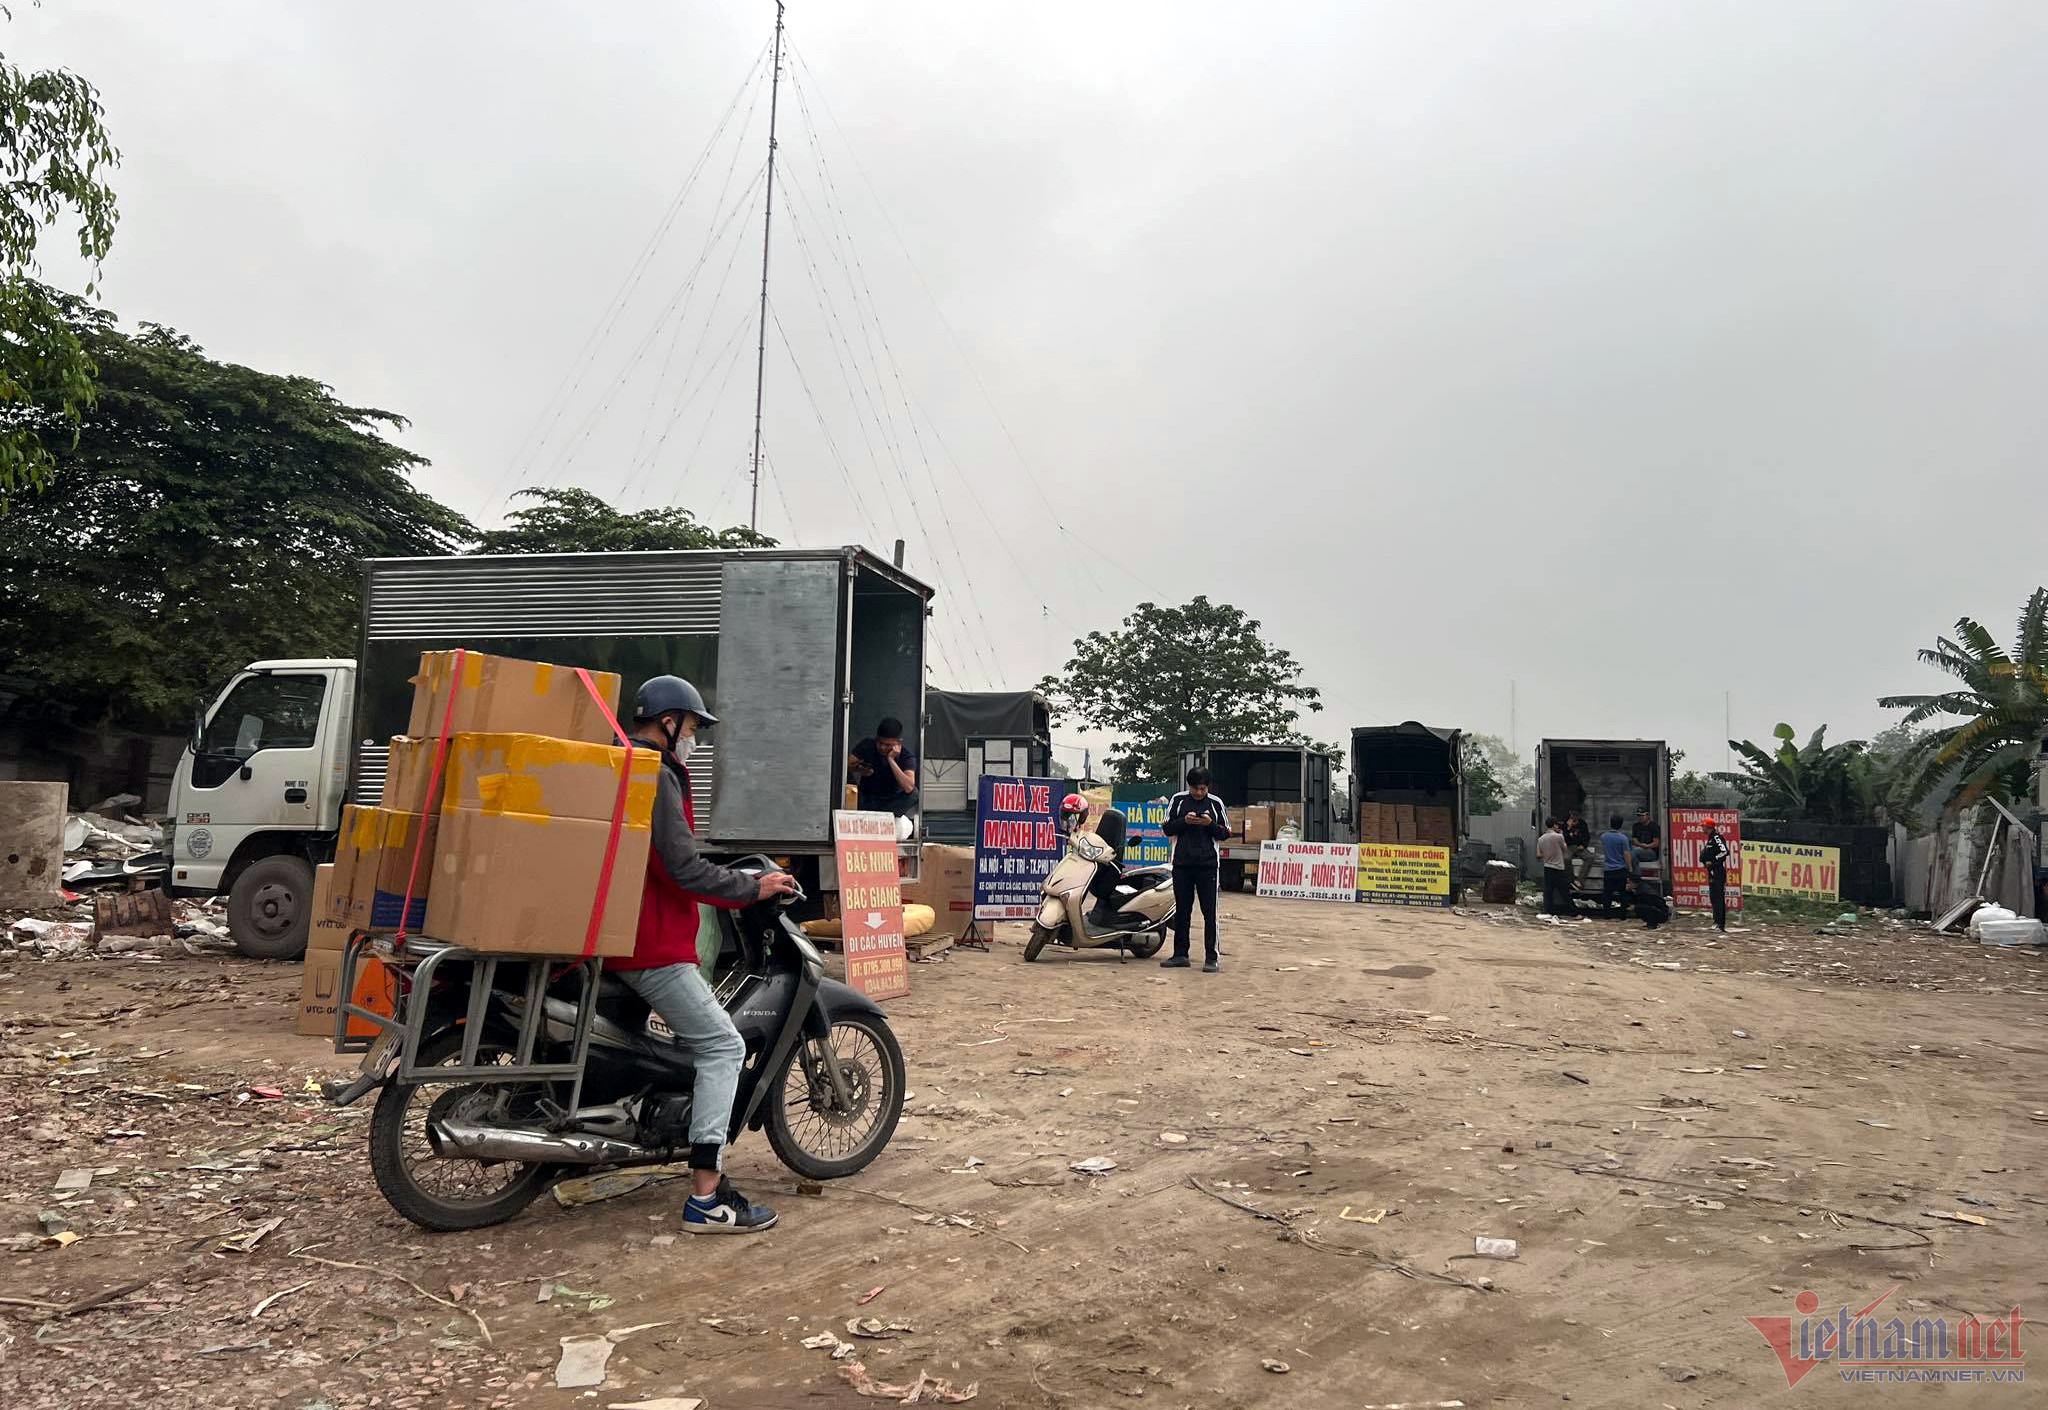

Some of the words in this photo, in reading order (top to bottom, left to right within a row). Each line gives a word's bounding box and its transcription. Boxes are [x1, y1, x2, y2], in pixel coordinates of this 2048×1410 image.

[993, 779, 1026, 812] NHÀ
[1029, 785, 1049, 813] XE
[1127, 804, 1144, 823] HÀ
[983, 819, 1032, 855] MẠNH
[1036, 817, 1057, 850] HÀ
[1144, 843, 1168, 862] BÌNH
[1288, 844, 1324, 855] QUANG
[1331, 846, 1352, 856] HUY
[1795, 848, 1823, 857] ANH
[870, 851, 895, 872] NINH
[1260, 857, 1280, 885] THÁI
[1281, 858, 1303, 886] BÌNH
[1338, 860, 1356, 889] YÊN
[1748, 855, 1780, 885] TÂY
[1791, 863, 1813, 888] BA
[1819, 860, 1836, 890] VÌ
[870, 887, 901, 908] GIANG
[849, 937, 859, 952] ĐI
[860, 932, 876, 951] CÁC
